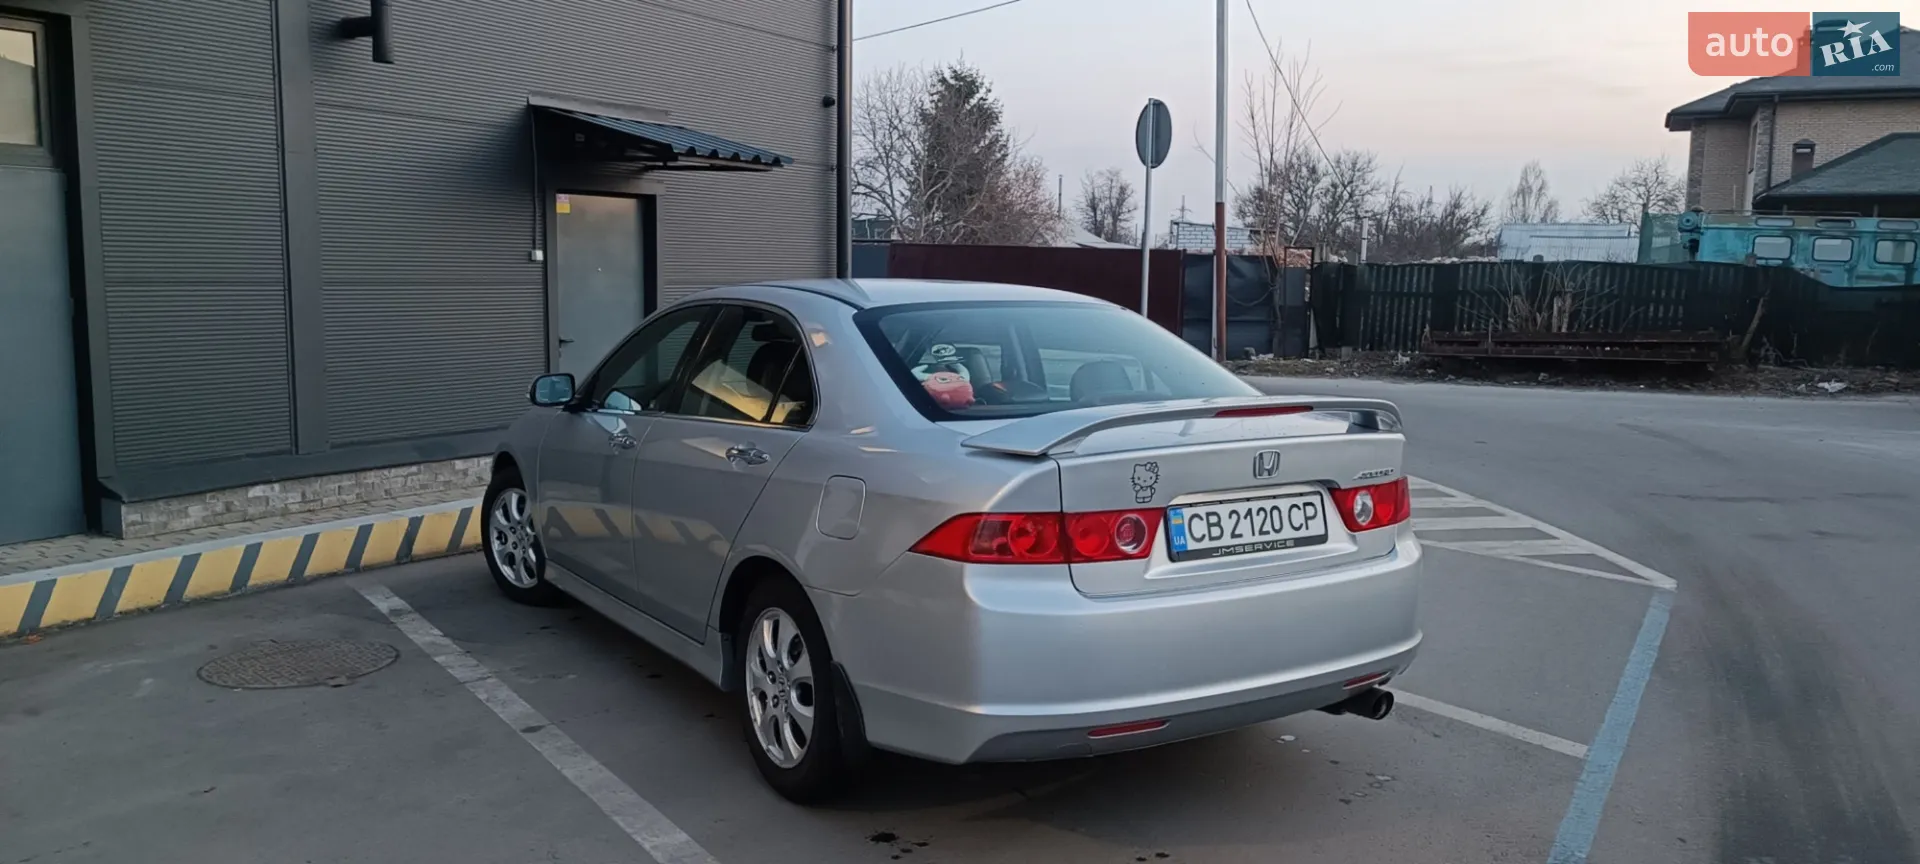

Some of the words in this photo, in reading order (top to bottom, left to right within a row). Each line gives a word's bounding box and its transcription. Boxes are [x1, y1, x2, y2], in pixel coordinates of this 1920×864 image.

[1188, 511, 1224, 543] CB
[1228, 505, 1284, 539] 2120
[1288, 501, 1318, 532] CP
[1173, 535, 1186, 545] UA
[1212, 539, 1295, 556] JMSERVICE
